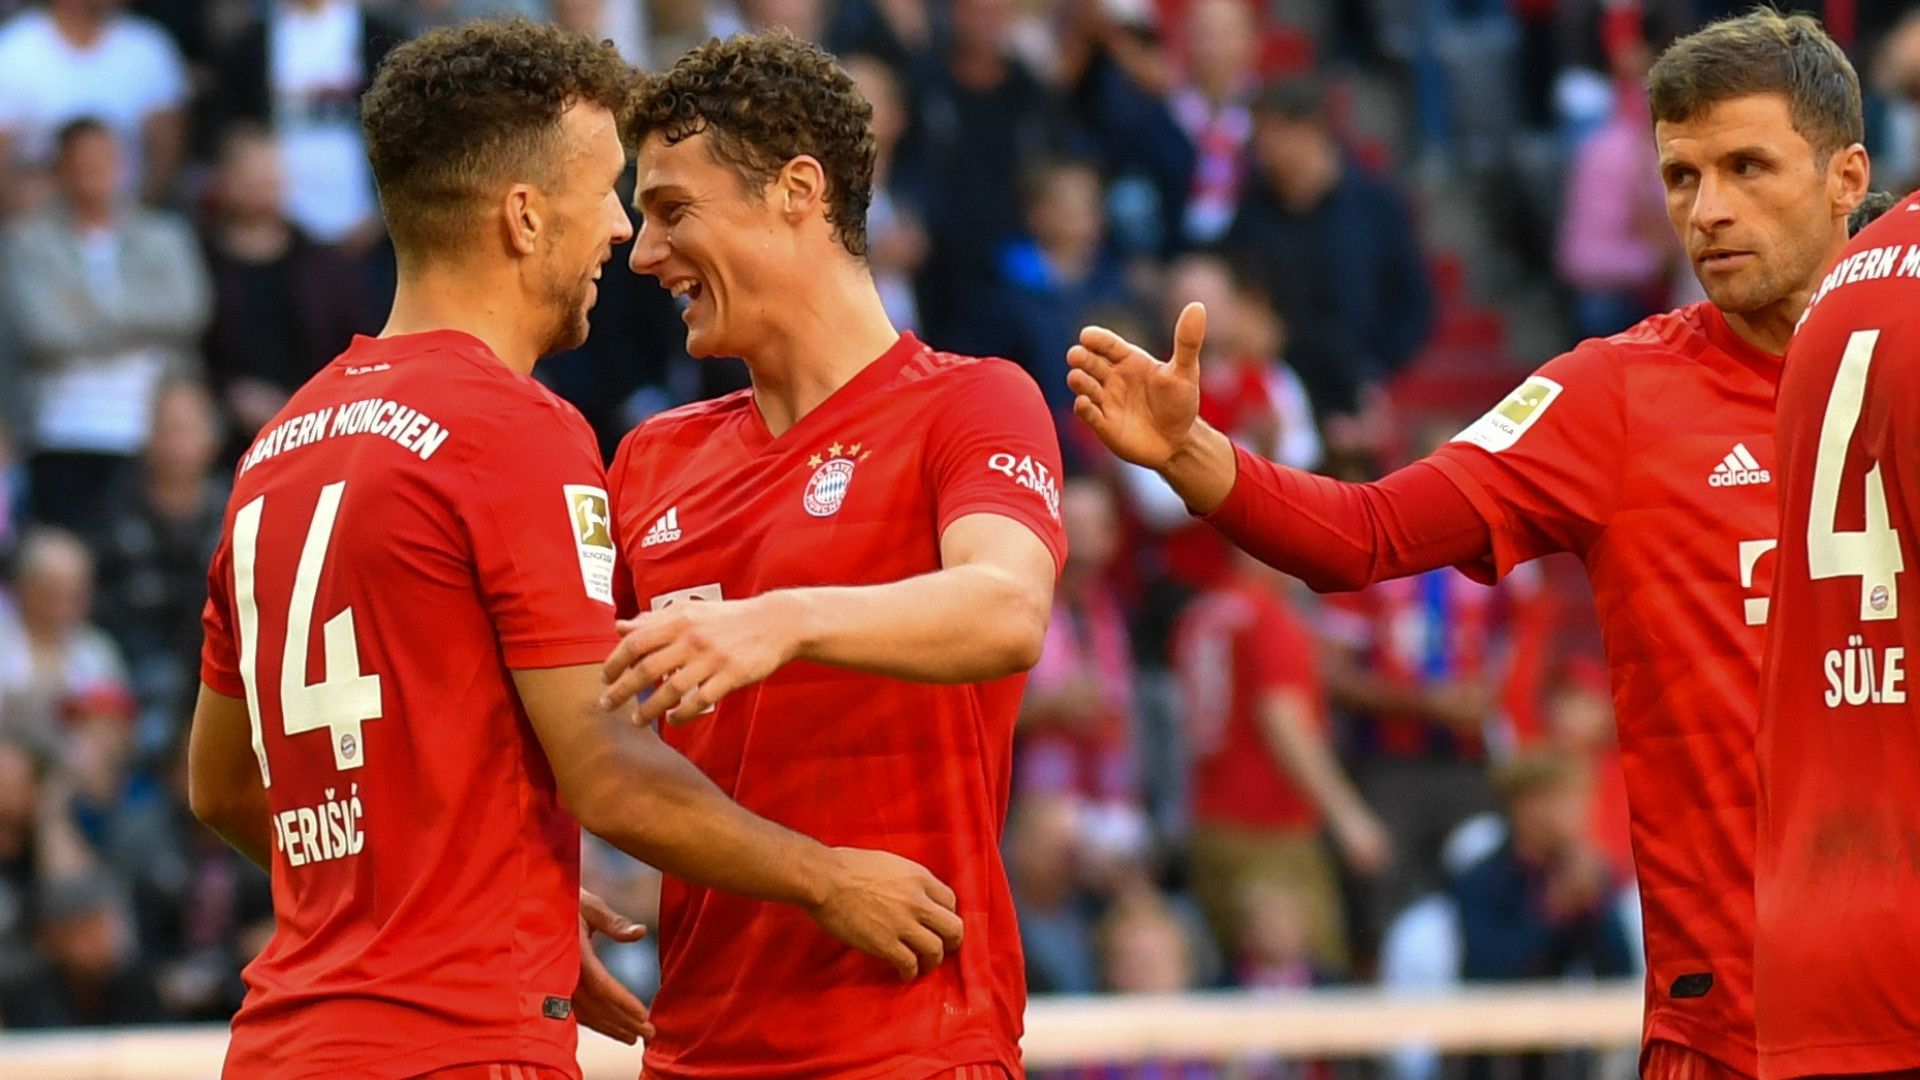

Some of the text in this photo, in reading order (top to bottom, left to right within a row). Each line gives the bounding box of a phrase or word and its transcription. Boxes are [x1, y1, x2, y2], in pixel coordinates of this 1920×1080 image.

[1708, 469, 1771, 487] adidas
[1807, 329, 1904, 621] 4
[641, 528, 682, 548] adidas
[233, 480, 383, 788] 14
[1824, 634, 1906, 708] SÜLE
